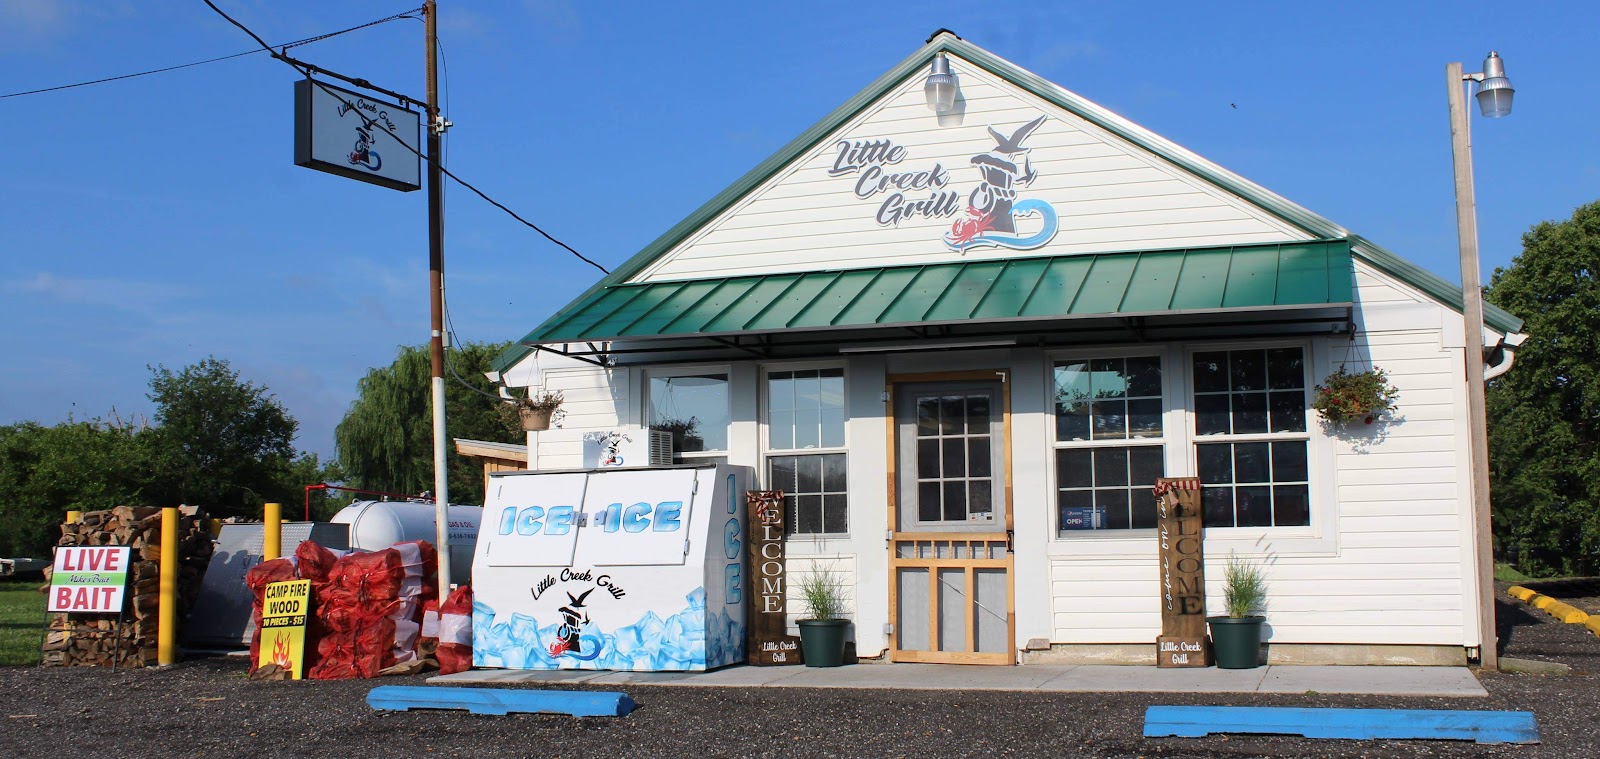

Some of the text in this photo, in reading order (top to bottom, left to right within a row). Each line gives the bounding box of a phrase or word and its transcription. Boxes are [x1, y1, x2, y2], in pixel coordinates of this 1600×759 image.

[357, 99, 377, 113] Creek
[379, 111, 396, 131] Grill
[828, 139, 907, 175] Little
[855, 164, 949, 198] Creek
[877, 191, 959, 227] Grill
[499, 505, 574, 536] ICE
[604, 501, 683, 533] ICE
[724, 473, 742, 604] ICE
[63, 549, 120, 571] LIVE
[92, 574, 110, 583] Bait
[531, 568, 626, 600] Little Creek Grill
[56, 587, 116, 610] BAIT
[266, 583, 307, 599] CAMP FIRE
[270, 600, 300, 614] WOOD
[270, 617, 289, 626] PIECES
[293, 616, 304, 625] $15
[762, 641, 798, 651] Little Creek
[1160, 641, 1202, 652] Little Creek
[772, 652, 786, 663] Grill
[1172, 653, 1189, 665] Grill
